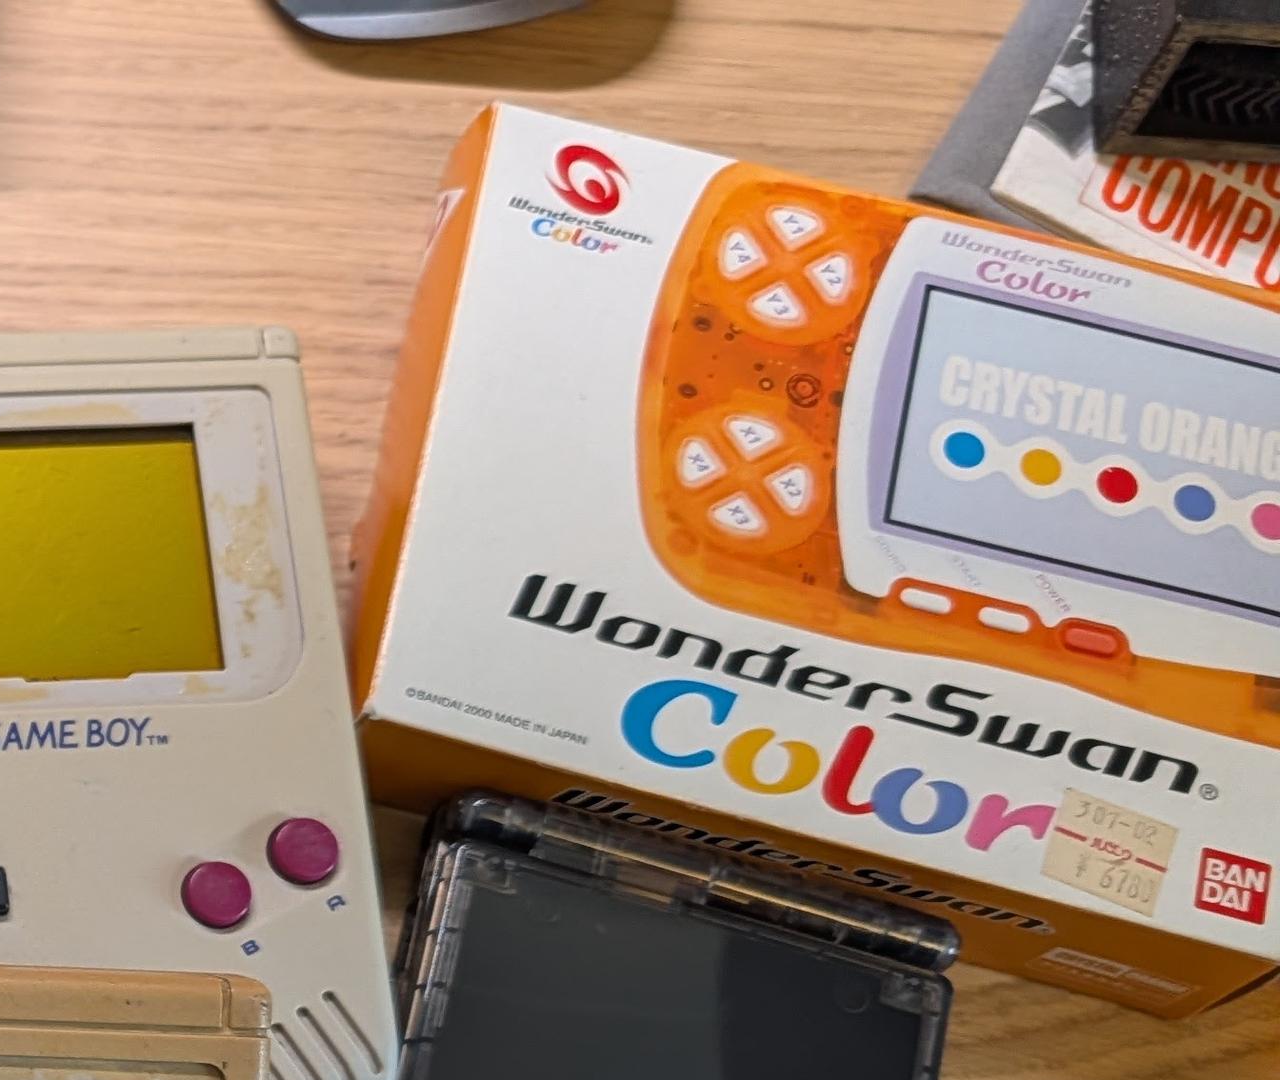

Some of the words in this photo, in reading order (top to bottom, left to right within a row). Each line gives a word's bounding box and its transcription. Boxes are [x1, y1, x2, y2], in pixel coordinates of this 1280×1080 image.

[508, 196, 648, 244] WonderSwan
[531, 218, 620, 254] Color
[941, 230, 1133, 288] WonderSwan
[976, 260, 1091, 302] Color
[940, 354, 1129, 444] CRYSTAL
[507, 574, 1199, 794] WonderSwan
[86, 715, 151, 750] BOY
[464, 704, 491, 720] 2000
[494, 712, 531, 731] MADE
[548, 726, 589, 746] JAPAN
[620, 679, 1058, 851] Color
[1204, 857, 1267, 893] BAN
[1202, 880, 1253, 913] DAI
[240, 938, 262, 958] B
